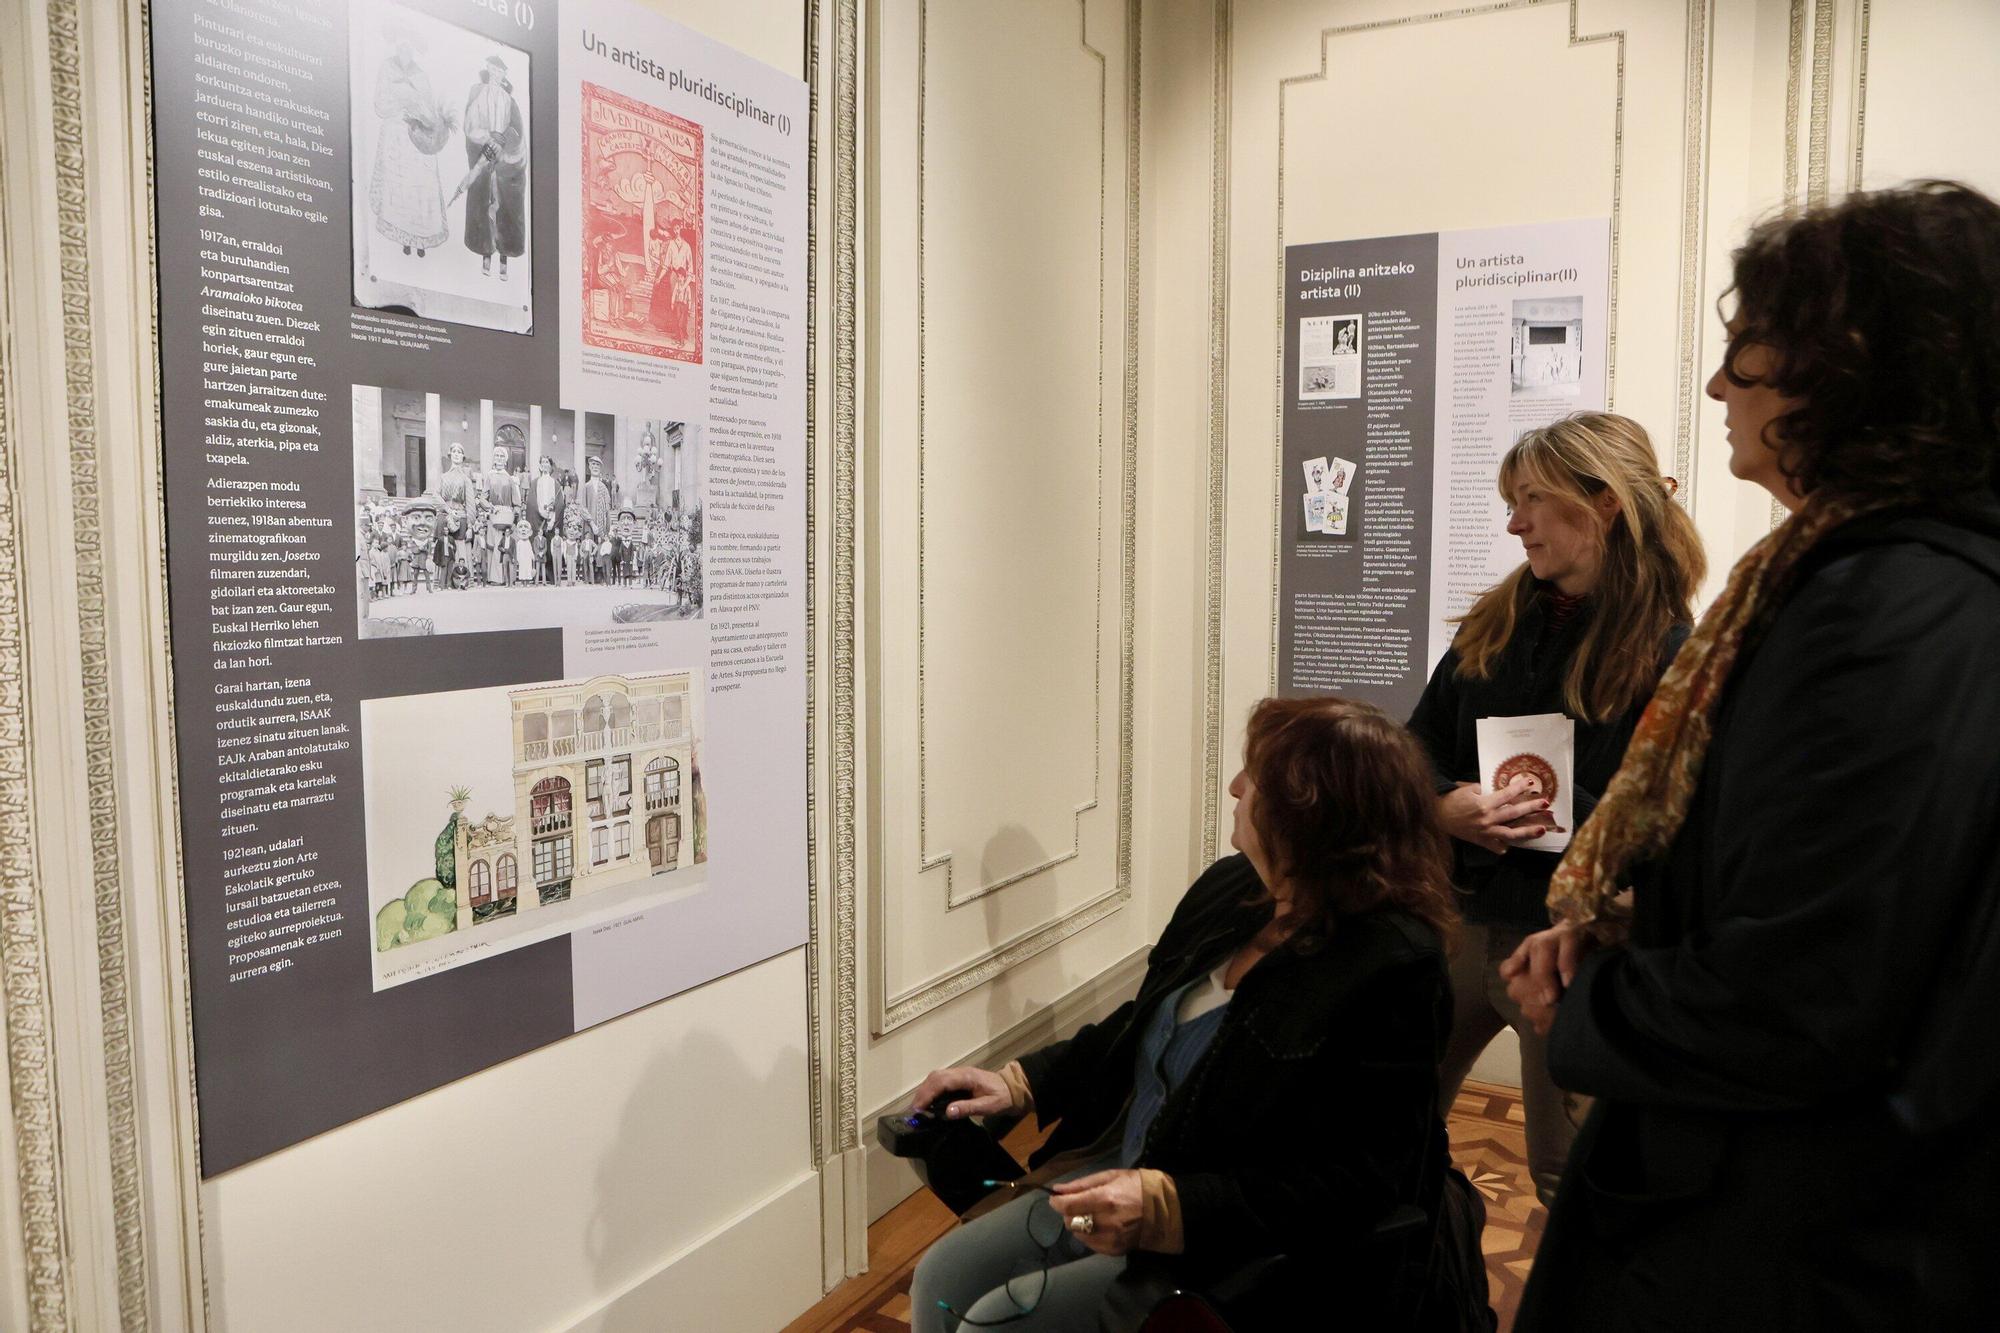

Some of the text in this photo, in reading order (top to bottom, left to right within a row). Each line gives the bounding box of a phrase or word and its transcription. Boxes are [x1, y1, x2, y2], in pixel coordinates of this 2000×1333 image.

[194, 53, 240, 75] aldiaren
[582, 29, 791, 136] Un artista pluridisciplinar (I)
[194, 89, 324, 136] jarduera handiko urteak
[196, 111, 333, 156] etorri ziren, eta, hala, Diez
[197, 149, 332, 191] euskal eszena artistikoan,
[198, 167, 312, 202] estilo errealistako eta
[198, 203, 224, 218] gisa.
[199, 228, 282, 255] 1917an, erraldoi
[1301, 261, 1414, 283] Diziplina anitzeko
[1456, 254, 1524, 269] Un artista
[201, 266, 294, 292] konpartsarentzat
[1456, 268, 1578, 291] pluridisciplinar(II)
[200, 285, 302, 311] Aramaioko bikotea
[1300, 284, 1361, 299] artista (II)
[202, 324, 304, 346] egin zituen erraldoi
[203, 340, 315, 366] horiek, gaur egun ere,
[204, 377, 326, 400] hartzen jarraitzen dute:
[204, 416, 320, 435] saskia du, eta gizonak,
[709, 413, 737, 423] Interesado
[205, 452, 249, 466] txapela.
[206, 477, 299, 491] Adierazpen modu
[207, 515, 332, 526] zuenez, 1918an abentura
[208, 532, 306, 545] zinematografikoan
[210, 567, 310, 579] filmaren zuzendari,
[211, 602, 332, 615] bat izan zen. Gaur egun,
[212, 618, 318, 633] Euskal Herriko lehen
[213, 655, 272, 669] da lan hori.
[214, 678, 310, 694] Garai hartan, izena
[216, 707, 331, 729] ordutik aurrera, ISAAK
[218, 740, 349, 765] EAJk Araban antolatutako
[219, 760, 322, 783] ekitaldietarako esku
[221, 823, 258, 836] zituen.
[223, 835, 303, 860] 1921ean, udalari
[225, 868, 314, 895] Eskolatik gertuko
[226, 880, 341, 912] lursail batzuetan etxea,
[227, 912, 343, 948] egiteko aurreproiektua.
[229, 958, 293, 982] aurrera egin.
